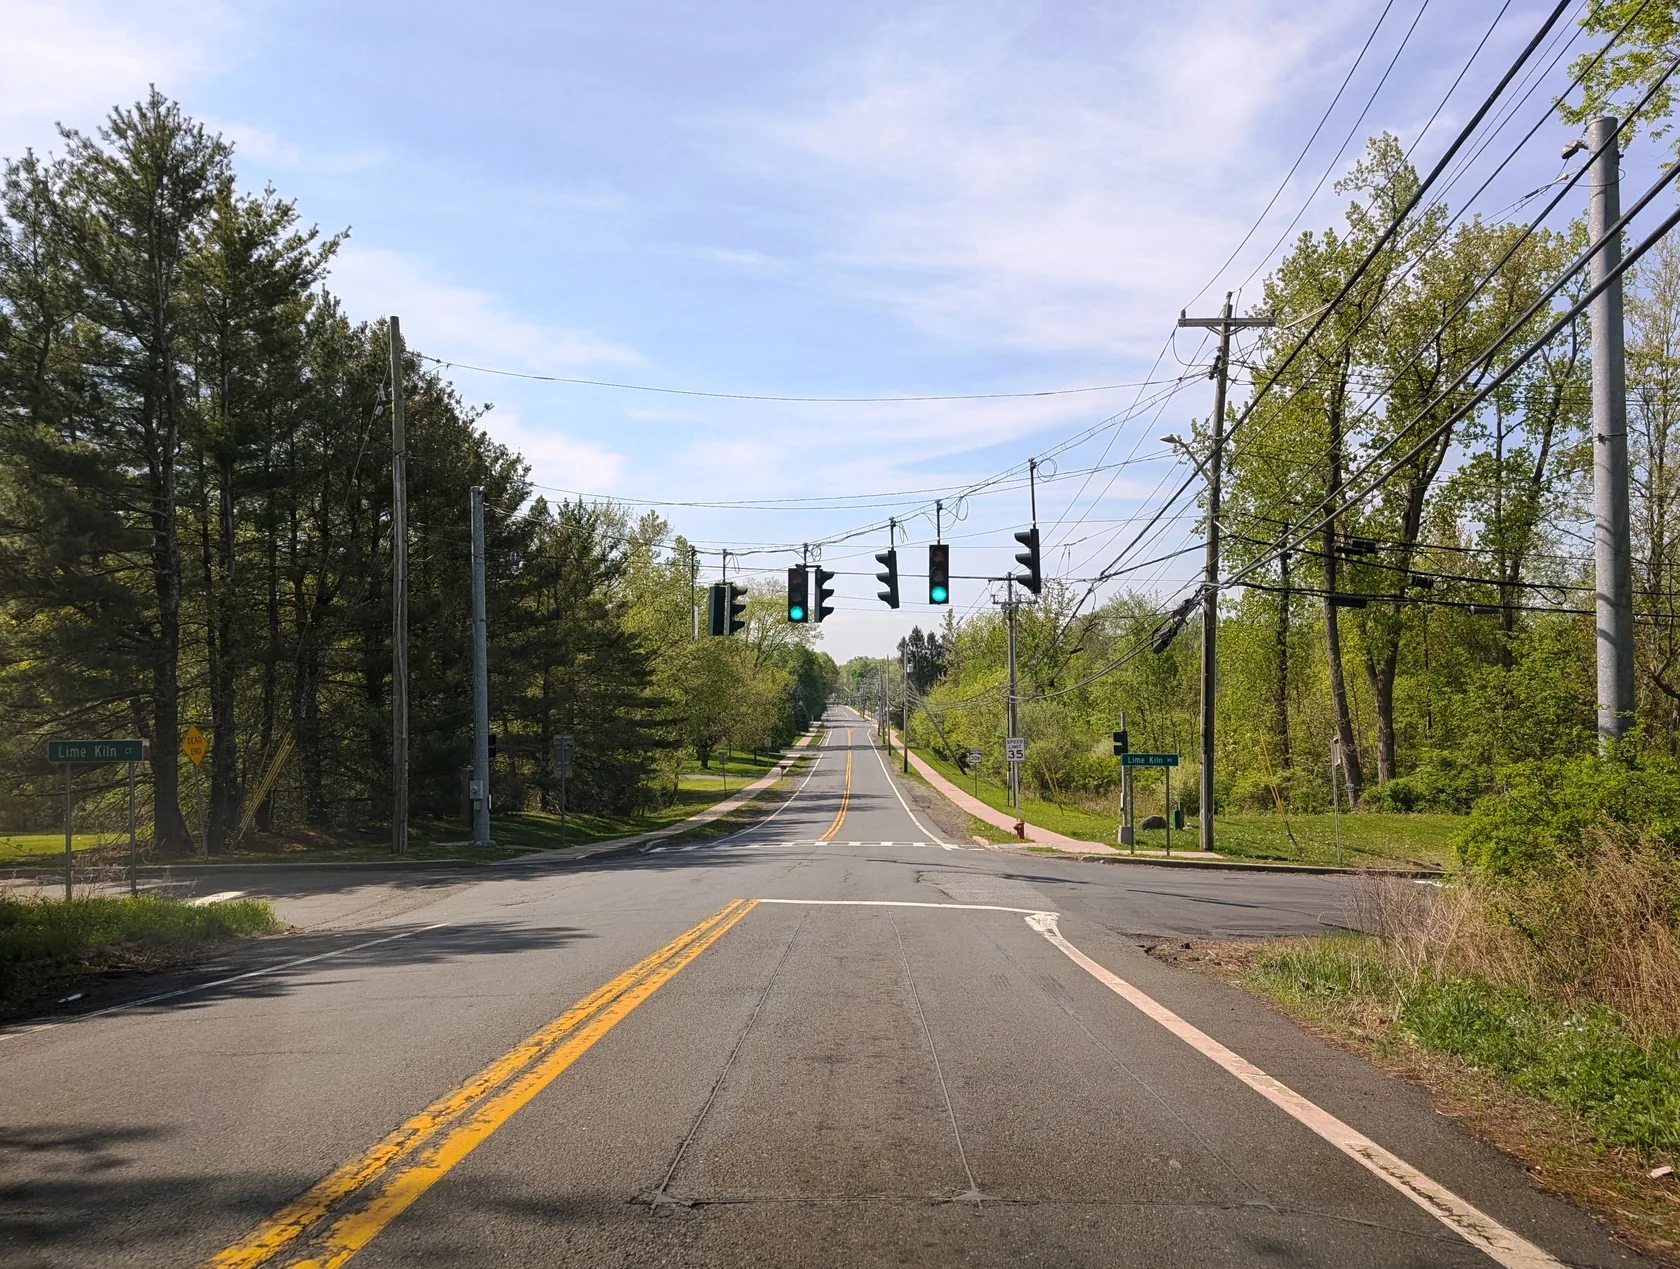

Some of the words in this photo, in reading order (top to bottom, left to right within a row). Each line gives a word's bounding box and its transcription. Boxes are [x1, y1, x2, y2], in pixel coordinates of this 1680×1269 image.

[187, 736, 202, 744] DEAD
[58, 745, 87, 758] Lime
[94, 745, 117, 757] Kiln
[1008, 750, 1024, 759] 35
[1127, 756, 1145, 764] Lime
[1149, 756, 1163, 764] Kiln
